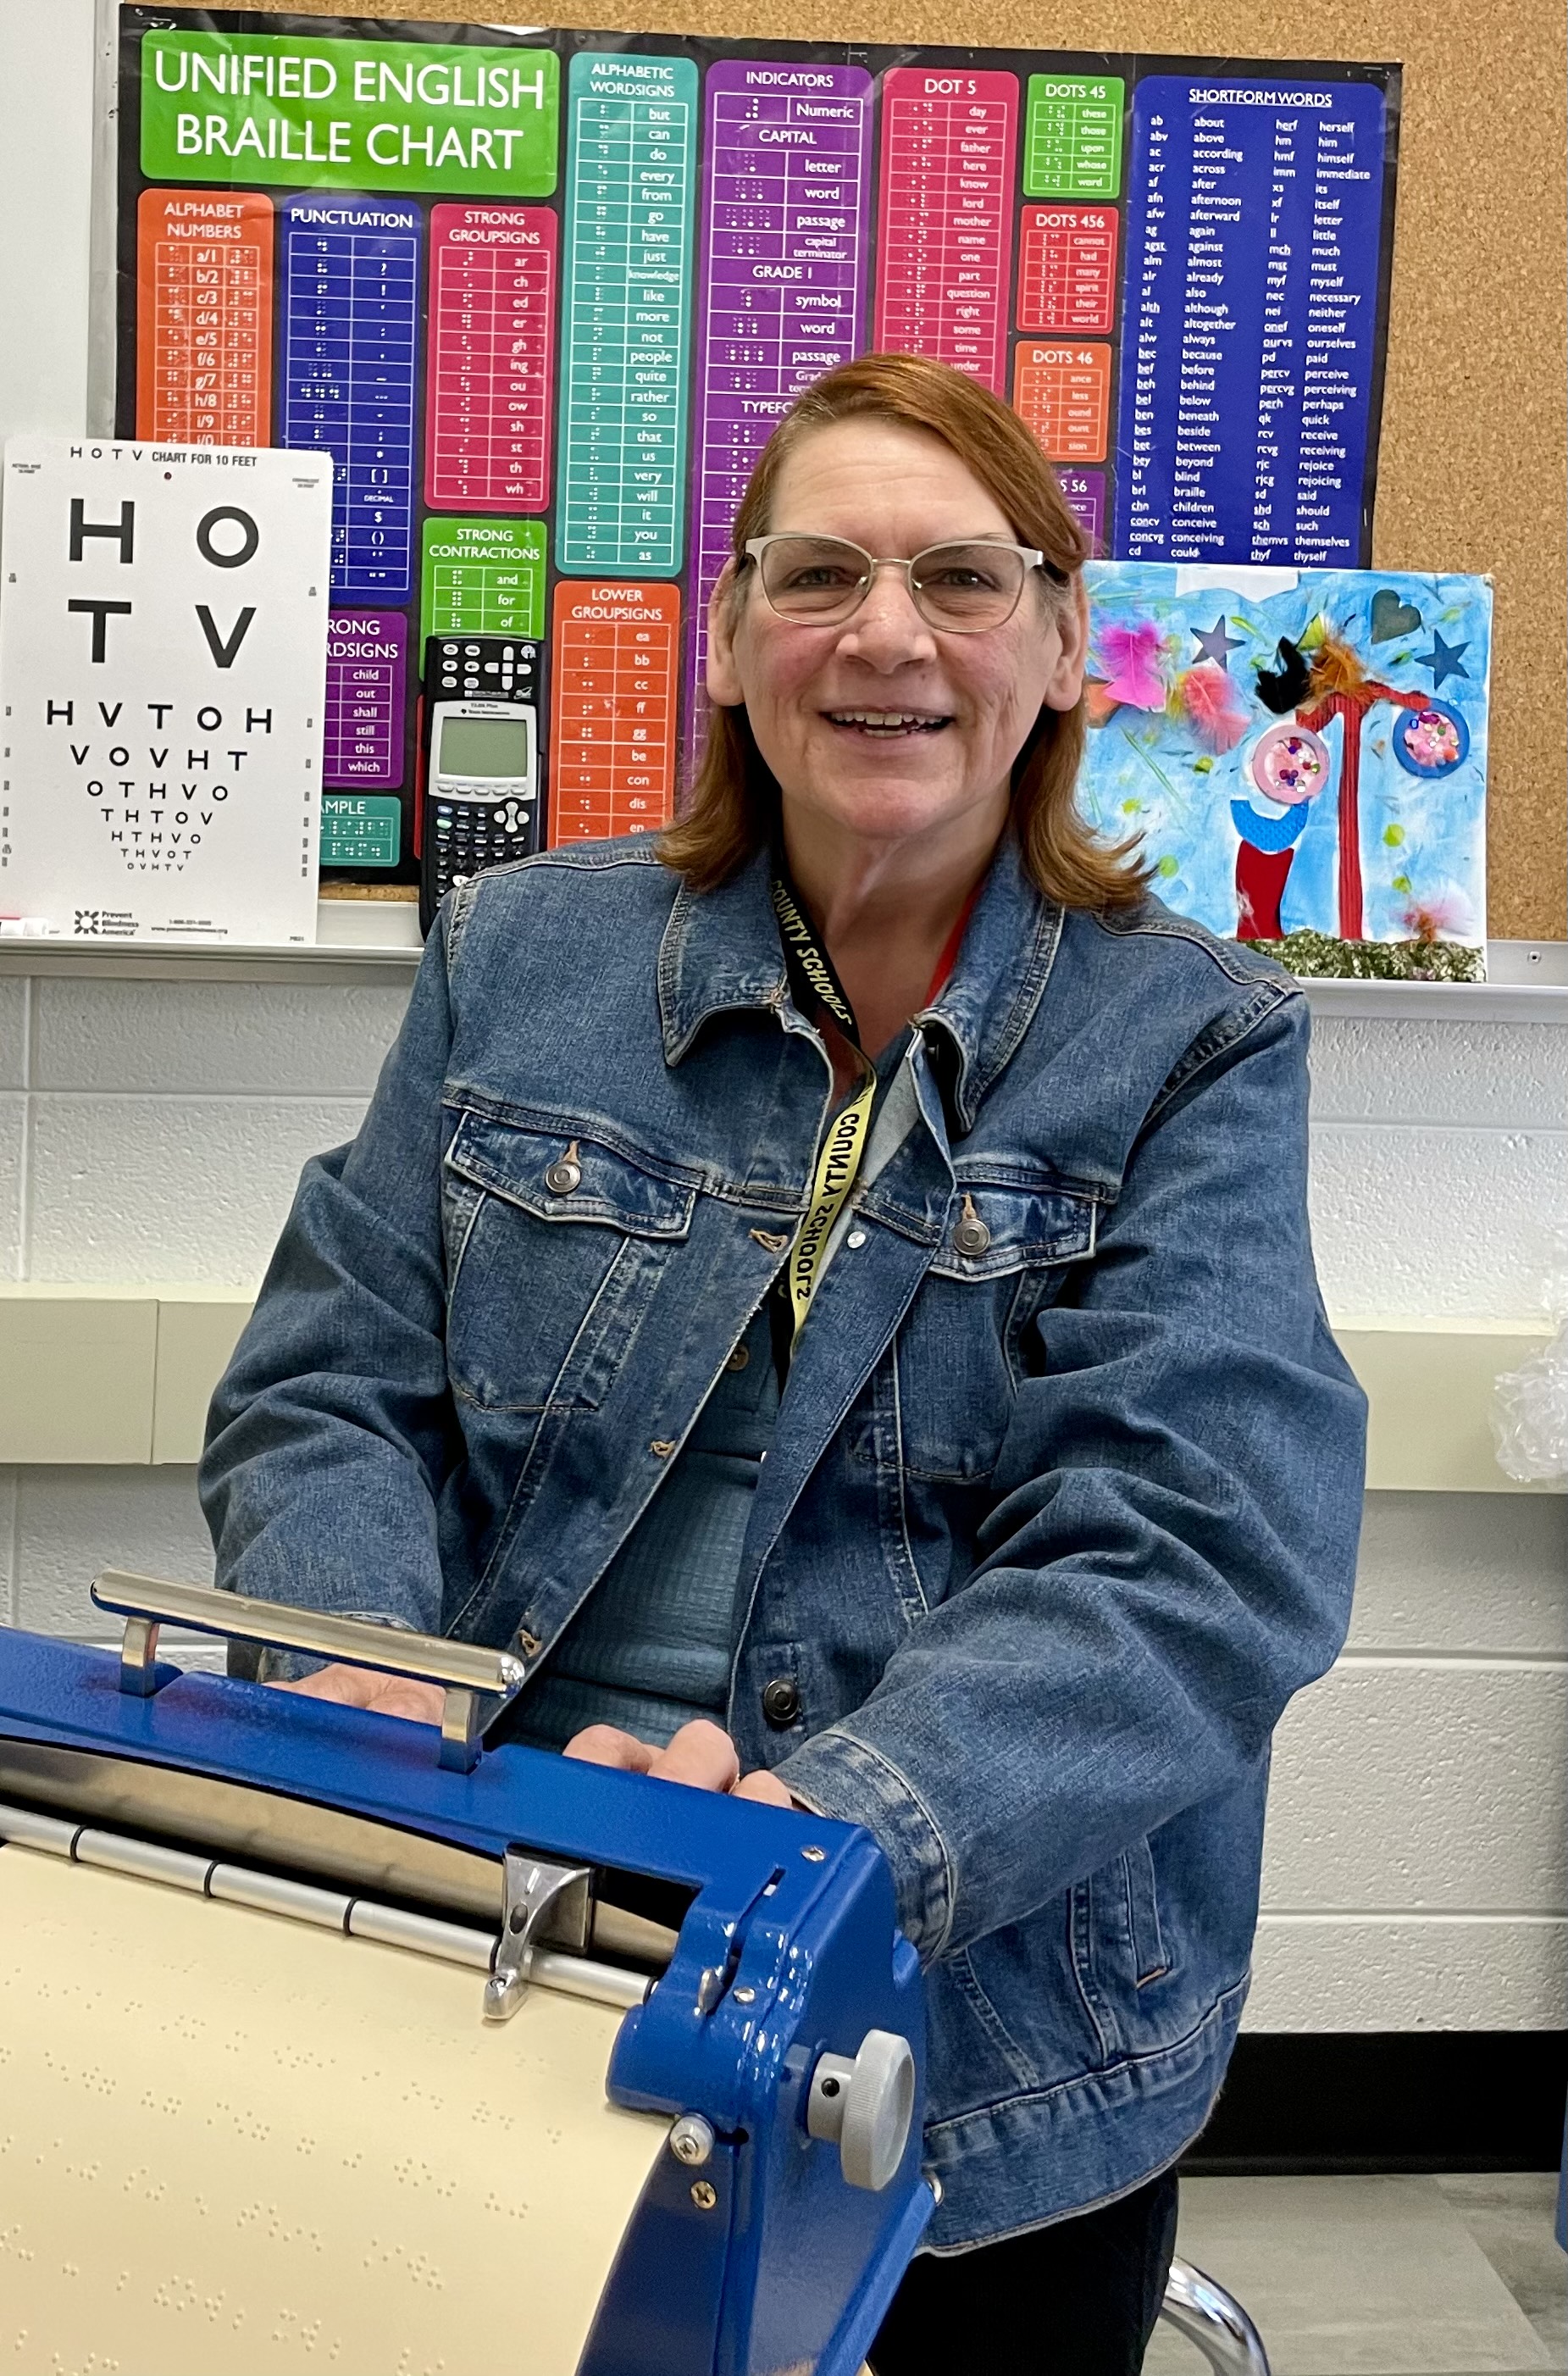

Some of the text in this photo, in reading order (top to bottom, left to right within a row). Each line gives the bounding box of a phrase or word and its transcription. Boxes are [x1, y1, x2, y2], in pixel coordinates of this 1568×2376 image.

[590, 63, 674, 80] ALPHABETIC
[155, 50, 544, 110] UNIFIED ENGLISH
[746, 71, 834, 88] INDICATORS
[924, 78, 977, 95] DOT 5
[590, 80, 675, 98] WORDSIGNS
[1045, 82, 1107, 100] DOTS 45
[1277, 92, 1333, 108] WORDS
[648, 108, 671, 121] but
[796, 103, 855, 119] Numeric
[968, 105, 987, 119] day
[1194, 116, 1225, 128] about
[1319, 120, 1355, 134] herself
[177, 114, 524, 170] BRAILLE CHART
[648, 130, 670, 141] can
[758, 129, 817, 145] CAPITAL
[1193, 131, 1225, 144] above
[960, 141, 992, 154] father
[1193, 147, 1244, 162] according
[1316, 152, 1355, 164] himself
[805, 158, 842, 174] letter
[1192, 164, 1226, 175] across
[640, 170, 675, 184] every
[1316, 168, 1371, 180] immediate
[959, 177, 989, 190] know
[641, 187, 673, 202] from
[804, 186, 840, 200] word
[1190, 193, 1242, 207] afternoon
[961, 197, 984, 209] lord
[163, 202, 246, 219] ALPHABET
[1189, 208, 1240, 222] afterward
[291, 208, 413, 229] PUNCTUATION
[464, 210, 525, 226] STRONG
[796, 215, 846, 231] passage
[953, 215, 992, 227] mother
[1035, 213, 1105, 229] DOTS 456
[1313, 214, 1344, 225] letter
[167, 223, 242, 239] NUMBERS
[448, 228, 540, 245] GROUPSIGNS
[641, 229, 670, 243] have
[1188, 225, 1216, 239] again
[804, 236, 837, 249] capital
[957, 236, 986, 246] name
[643, 249, 667, 264] just
[793, 248, 848, 259] terminator
[1187, 255, 1222, 268] almost
[196, 269, 219, 285] b/2
[752, 264, 803, 280] GRADE
[958, 272, 981, 284] part
[513, 275, 529, 288] ch
[1310, 276, 1344, 289] myself
[196, 290, 218, 305] c/3
[643, 289, 665, 303] like
[795, 293, 842, 309] symbol
[946, 288, 991, 301] question
[1309, 293, 1361, 304] necessary
[956, 305, 980, 319] right
[1184, 302, 1229, 316] although
[195, 311, 219, 325] d/4
[635, 312, 670, 323] more
[800, 321, 835, 335] word
[195, 331, 218, 347] e/5
[641, 333, 663, 343] not
[1306, 337, 1356, 349] ourselves
[511, 338, 527, 355] gh
[954, 342, 978, 354] time
[197, 352, 216, 367] f/6
[629, 350, 673, 364] people
[792, 352, 841, 366] passage
[1032, 349, 1094, 365] DOTS 46
[1182, 348, 1223, 361] because
[509, 358, 529, 375] ing
[1181, 364, 1215, 376] before
[634, 369, 667, 385] quite
[1180, 379, 1216, 391] behind
[195, 393, 218, 408] h/8
[630, 390, 670, 403] rather
[1071, 391, 1089, 402] less
[1302, 398, 1344, 411] perhaps
[197, 414, 215, 429] i/9
[1178, 409, 1220, 422] beneath
[510, 420, 524, 432] sh
[636, 430, 662, 443] that
[1299, 445, 1346, 457] receiving
[152, 451, 187, 464] CHART
[191, 452, 212, 465] FOR
[215, 454, 229, 466] 10
[231, 455, 258, 467] FEET
[633, 470, 662, 484] very
[1174, 470, 1200, 482] blind
[1298, 475, 1342, 488] rejoicing
[505, 482, 524, 494] wh
[1070, 479, 1089, 494] 56
[1173, 486, 1206, 498] braille
[363, 494, 394, 503] DECIMAL
[636, 489, 658, 502] will
[1172, 501, 1215, 514] children
[1172, 517, 1217, 529] conceive
[69, 497, 259, 569] H O
[457, 528, 513, 542] STRONG
[634, 530, 658, 541] you
[1294, 535, 1350, 547] themselves
[429, 544, 540, 560] CONTRACTIONS
[496, 574, 518, 586] and
[497, 593, 516, 606] for
[591, 588, 644, 602] LOWER
[571, 605, 662, 621] GROUPSIGNS
[327, 619, 381, 636] RONG
[500, 615, 513, 628] of
[68, 598, 257, 669] T V
[634, 653, 651, 666] bb
[352, 669, 380, 680] child
[356, 690, 376, 699] out
[352, 706, 378, 718] shall
[356, 724, 375, 736] still
[354, 742, 375, 754] this
[347, 760, 380, 773] which
[627, 775, 650, 786] con
[320, 800, 367, 815] MPLE
[629, 797, 647, 810] dis
[795, 947, 852, 1025] SCHOOLS
